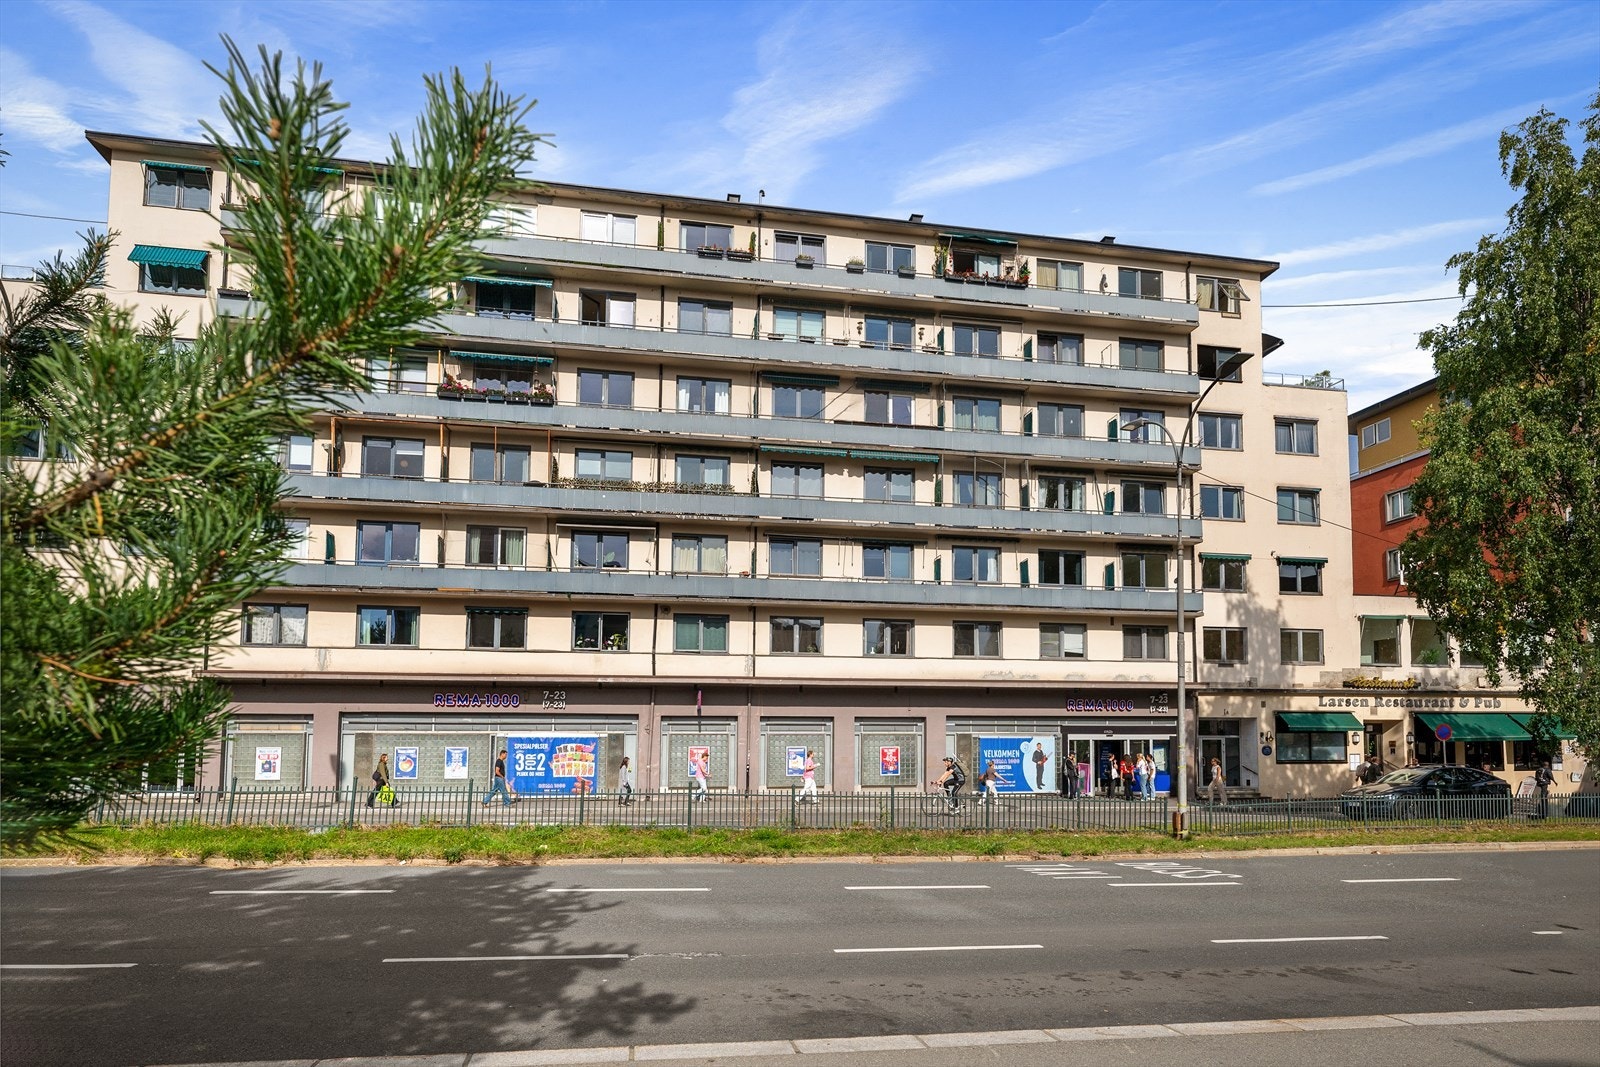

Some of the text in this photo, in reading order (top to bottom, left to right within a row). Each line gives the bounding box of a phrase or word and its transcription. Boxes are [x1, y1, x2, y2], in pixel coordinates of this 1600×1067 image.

[433, 692, 520, 708] REMA 1000
[543, 690, 566, 700] 7-23
[1149, 694, 1169, 704] 7-23
[542, 700, 566, 710] (7-23)
[1066, 698, 1134, 712] REMA 1000
[1318, 696, 1502, 709] Larsen Restaurant & Pub
[983, 749, 1020, 758] VELKOMMEN
[515, 753, 546, 771] 3 FOR 2
[1004, 863, 1123, 879] TAXI
[1114, 862, 1243, 879] BUSS
